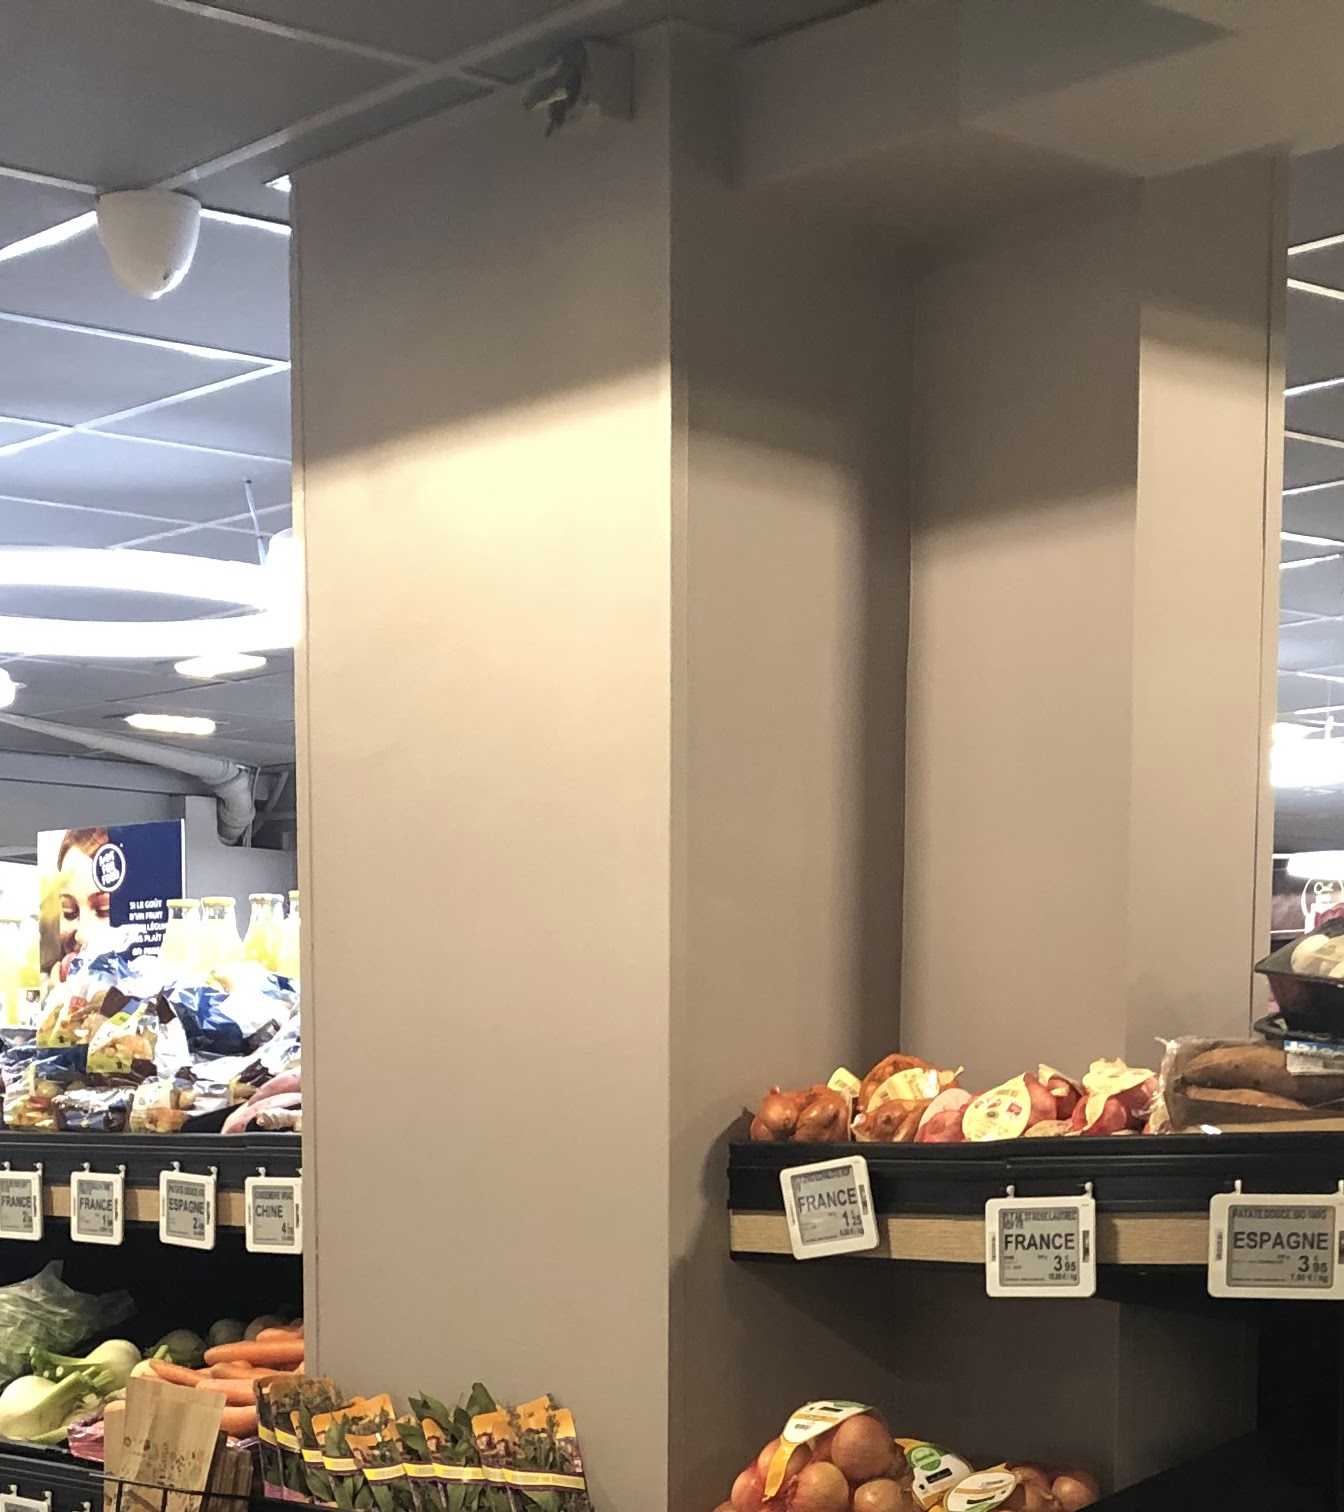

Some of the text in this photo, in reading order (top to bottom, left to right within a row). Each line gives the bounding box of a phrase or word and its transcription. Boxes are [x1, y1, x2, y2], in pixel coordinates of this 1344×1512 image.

[1, 1195, 32, 1208] FRANCE
[80, 1197, 113, 1211] FRANCE
[169, 1198, 204, 1214] ESPAGNE
[798, 1187, 858, 1213] FRANCE
[255, 1204, 283, 1218] CHINE
[1004, 1233, 1075, 1250] FRANCE
[1233, 1231, 1328, 1250] ESPAGNE
